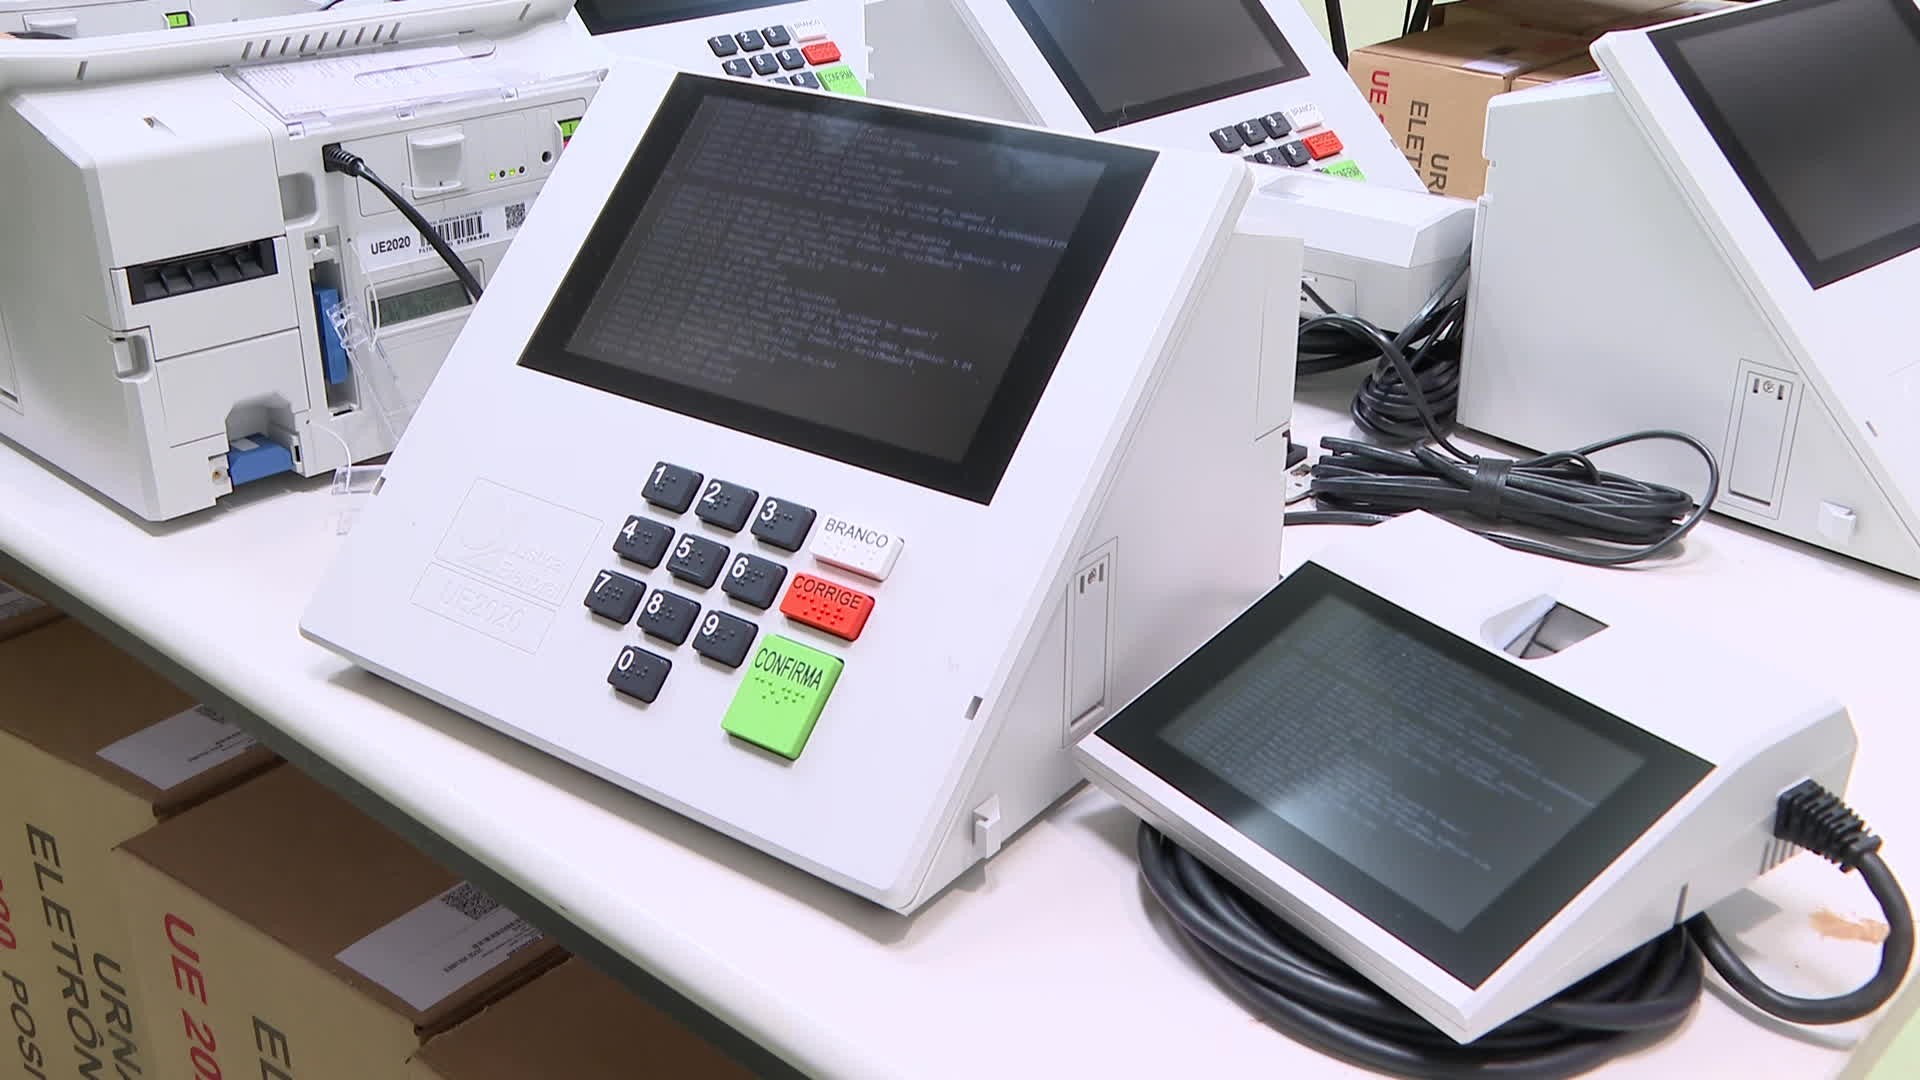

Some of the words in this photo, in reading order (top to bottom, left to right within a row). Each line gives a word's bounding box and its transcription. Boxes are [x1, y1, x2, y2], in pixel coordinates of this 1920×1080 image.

[714, 38, 722, 47] 1
[740, 33, 750, 43] 2
[767, 28, 776, 38] 3
[755, 56, 764, 66] 5
[782, 51, 791, 61] 6
[1369, 70, 1391, 105] UE
[1243, 123, 1254, 134] 2
[1267, 115, 1277, 127] 3
[1218, 130, 1228, 141] 1
[1405, 100, 1429, 176] ELET
[1263, 151, 1273, 163] 5
[1286, 143, 1297, 155] 6
[370, 235, 411, 255] UE2020
[654, 465, 667, 486] 1
[703, 482, 722, 504] 2
[761, 500, 777, 522] 3
[622, 519, 640, 542] 4
[824, 517, 889, 549] BRANCO
[676, 538, 695, 559] 5
[732, 557, 749, 578] 6
[593, 572, 612, 594] 7
[792, 574, 864, 610] CORRIGE
[646, 592, 664, 615] 8
[702, 614, 720, 636] 9
[617, 649, 635, 672] 0
[754, 647, 824, 691] CONFIRMA
[164, 912, 208, 1006] UE
[181, 1007, 223, 1080] 20
